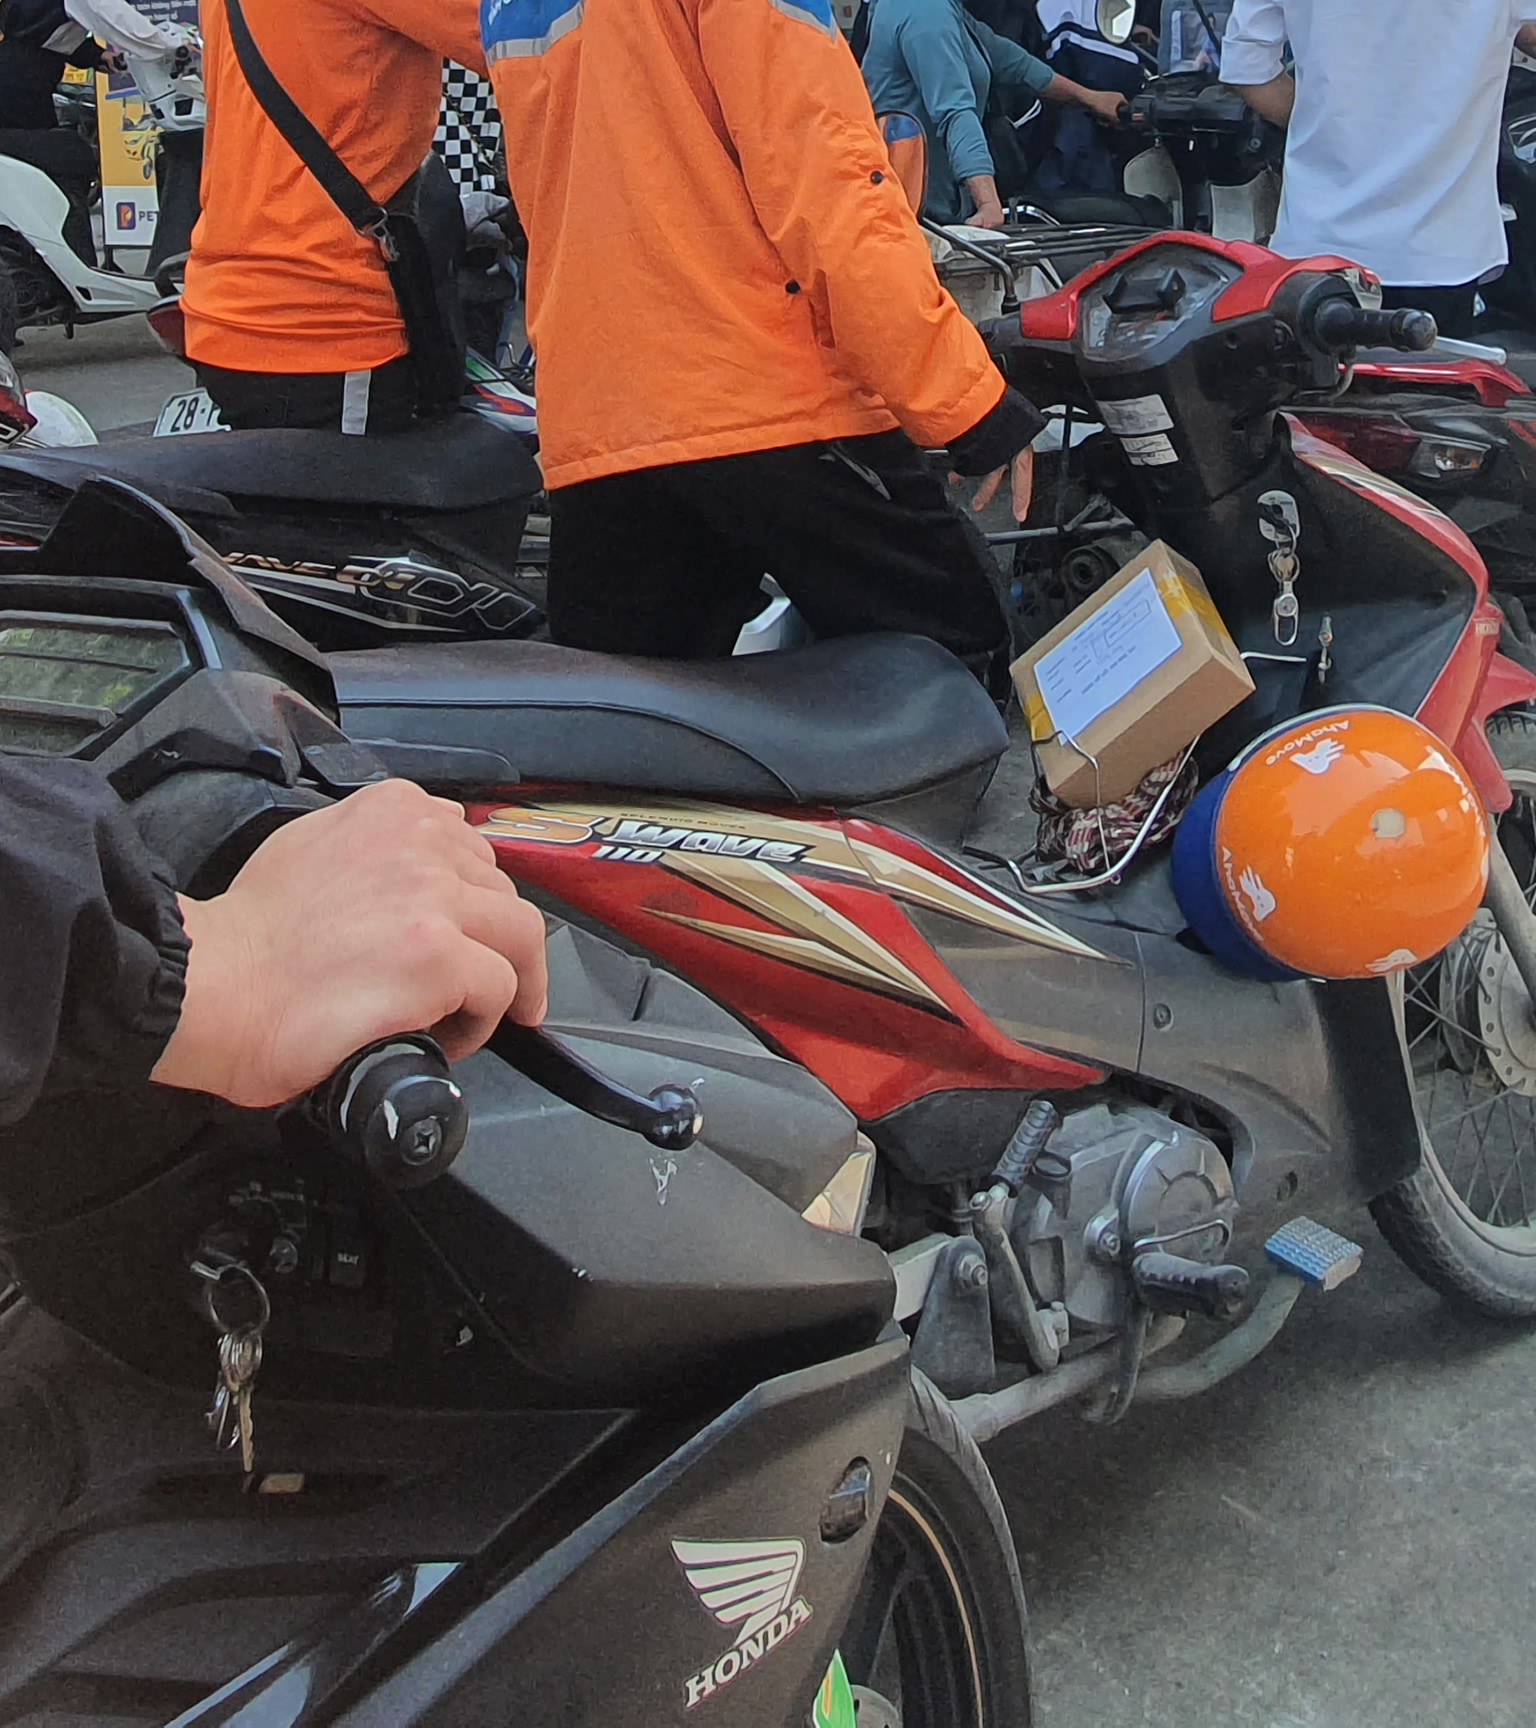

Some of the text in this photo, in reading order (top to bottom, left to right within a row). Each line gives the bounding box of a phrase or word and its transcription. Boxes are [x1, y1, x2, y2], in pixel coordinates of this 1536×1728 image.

[1265, 720, 1351, 766] AhaMove
[590, 845, 666, 863] 110
[601, 820, 814, 863] Wave
[685, 1597, 811, 1708] HONDA
